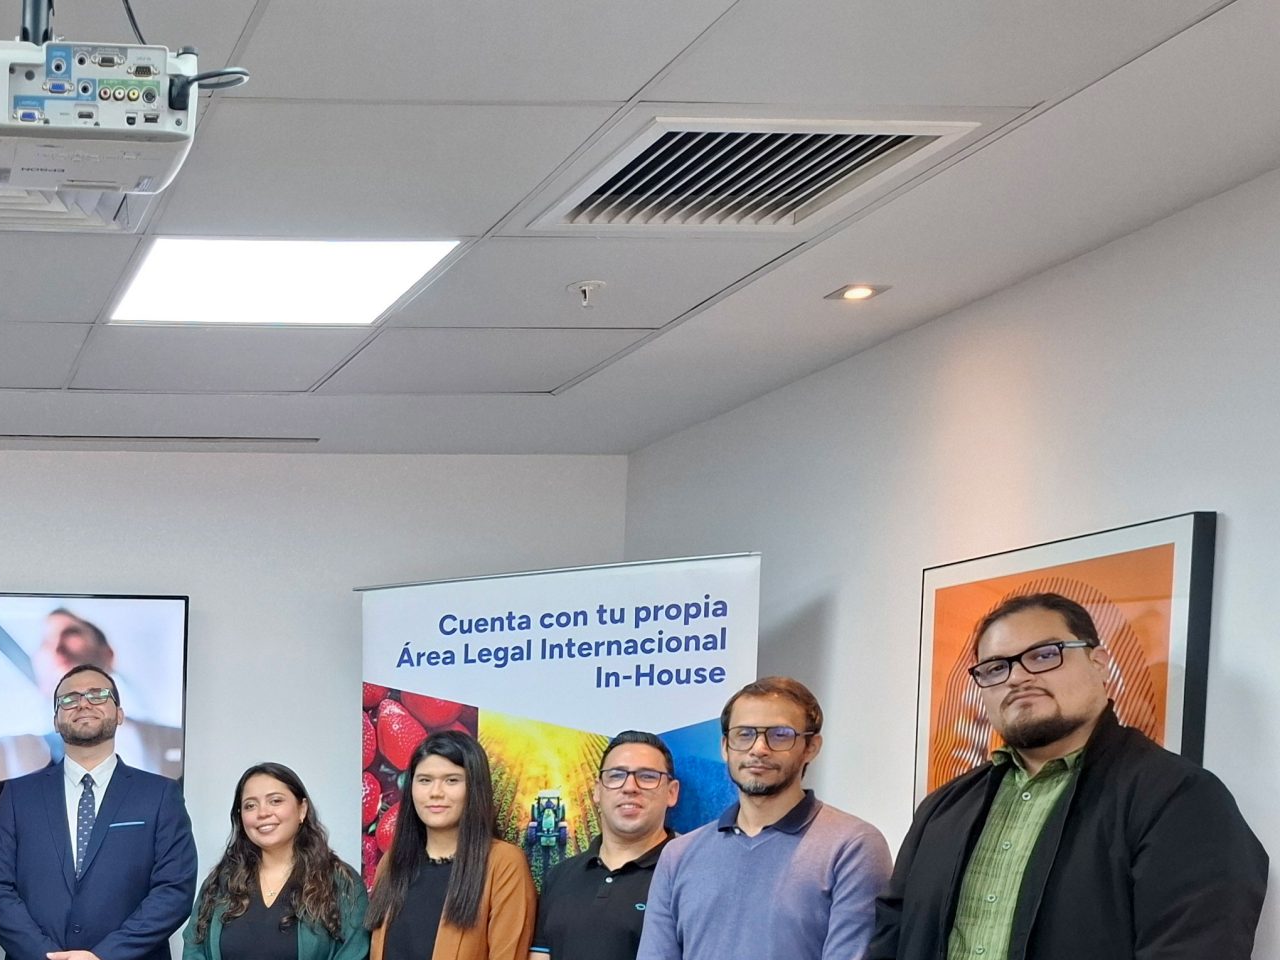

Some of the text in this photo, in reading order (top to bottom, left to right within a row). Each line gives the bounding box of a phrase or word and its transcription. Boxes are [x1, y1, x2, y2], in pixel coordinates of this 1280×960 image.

[438, 594, 728, 636] Cuenta con tu propia
[396, 627, 727, 668] Área Legal Internacional
[596, 662, 726, 689] In-House
